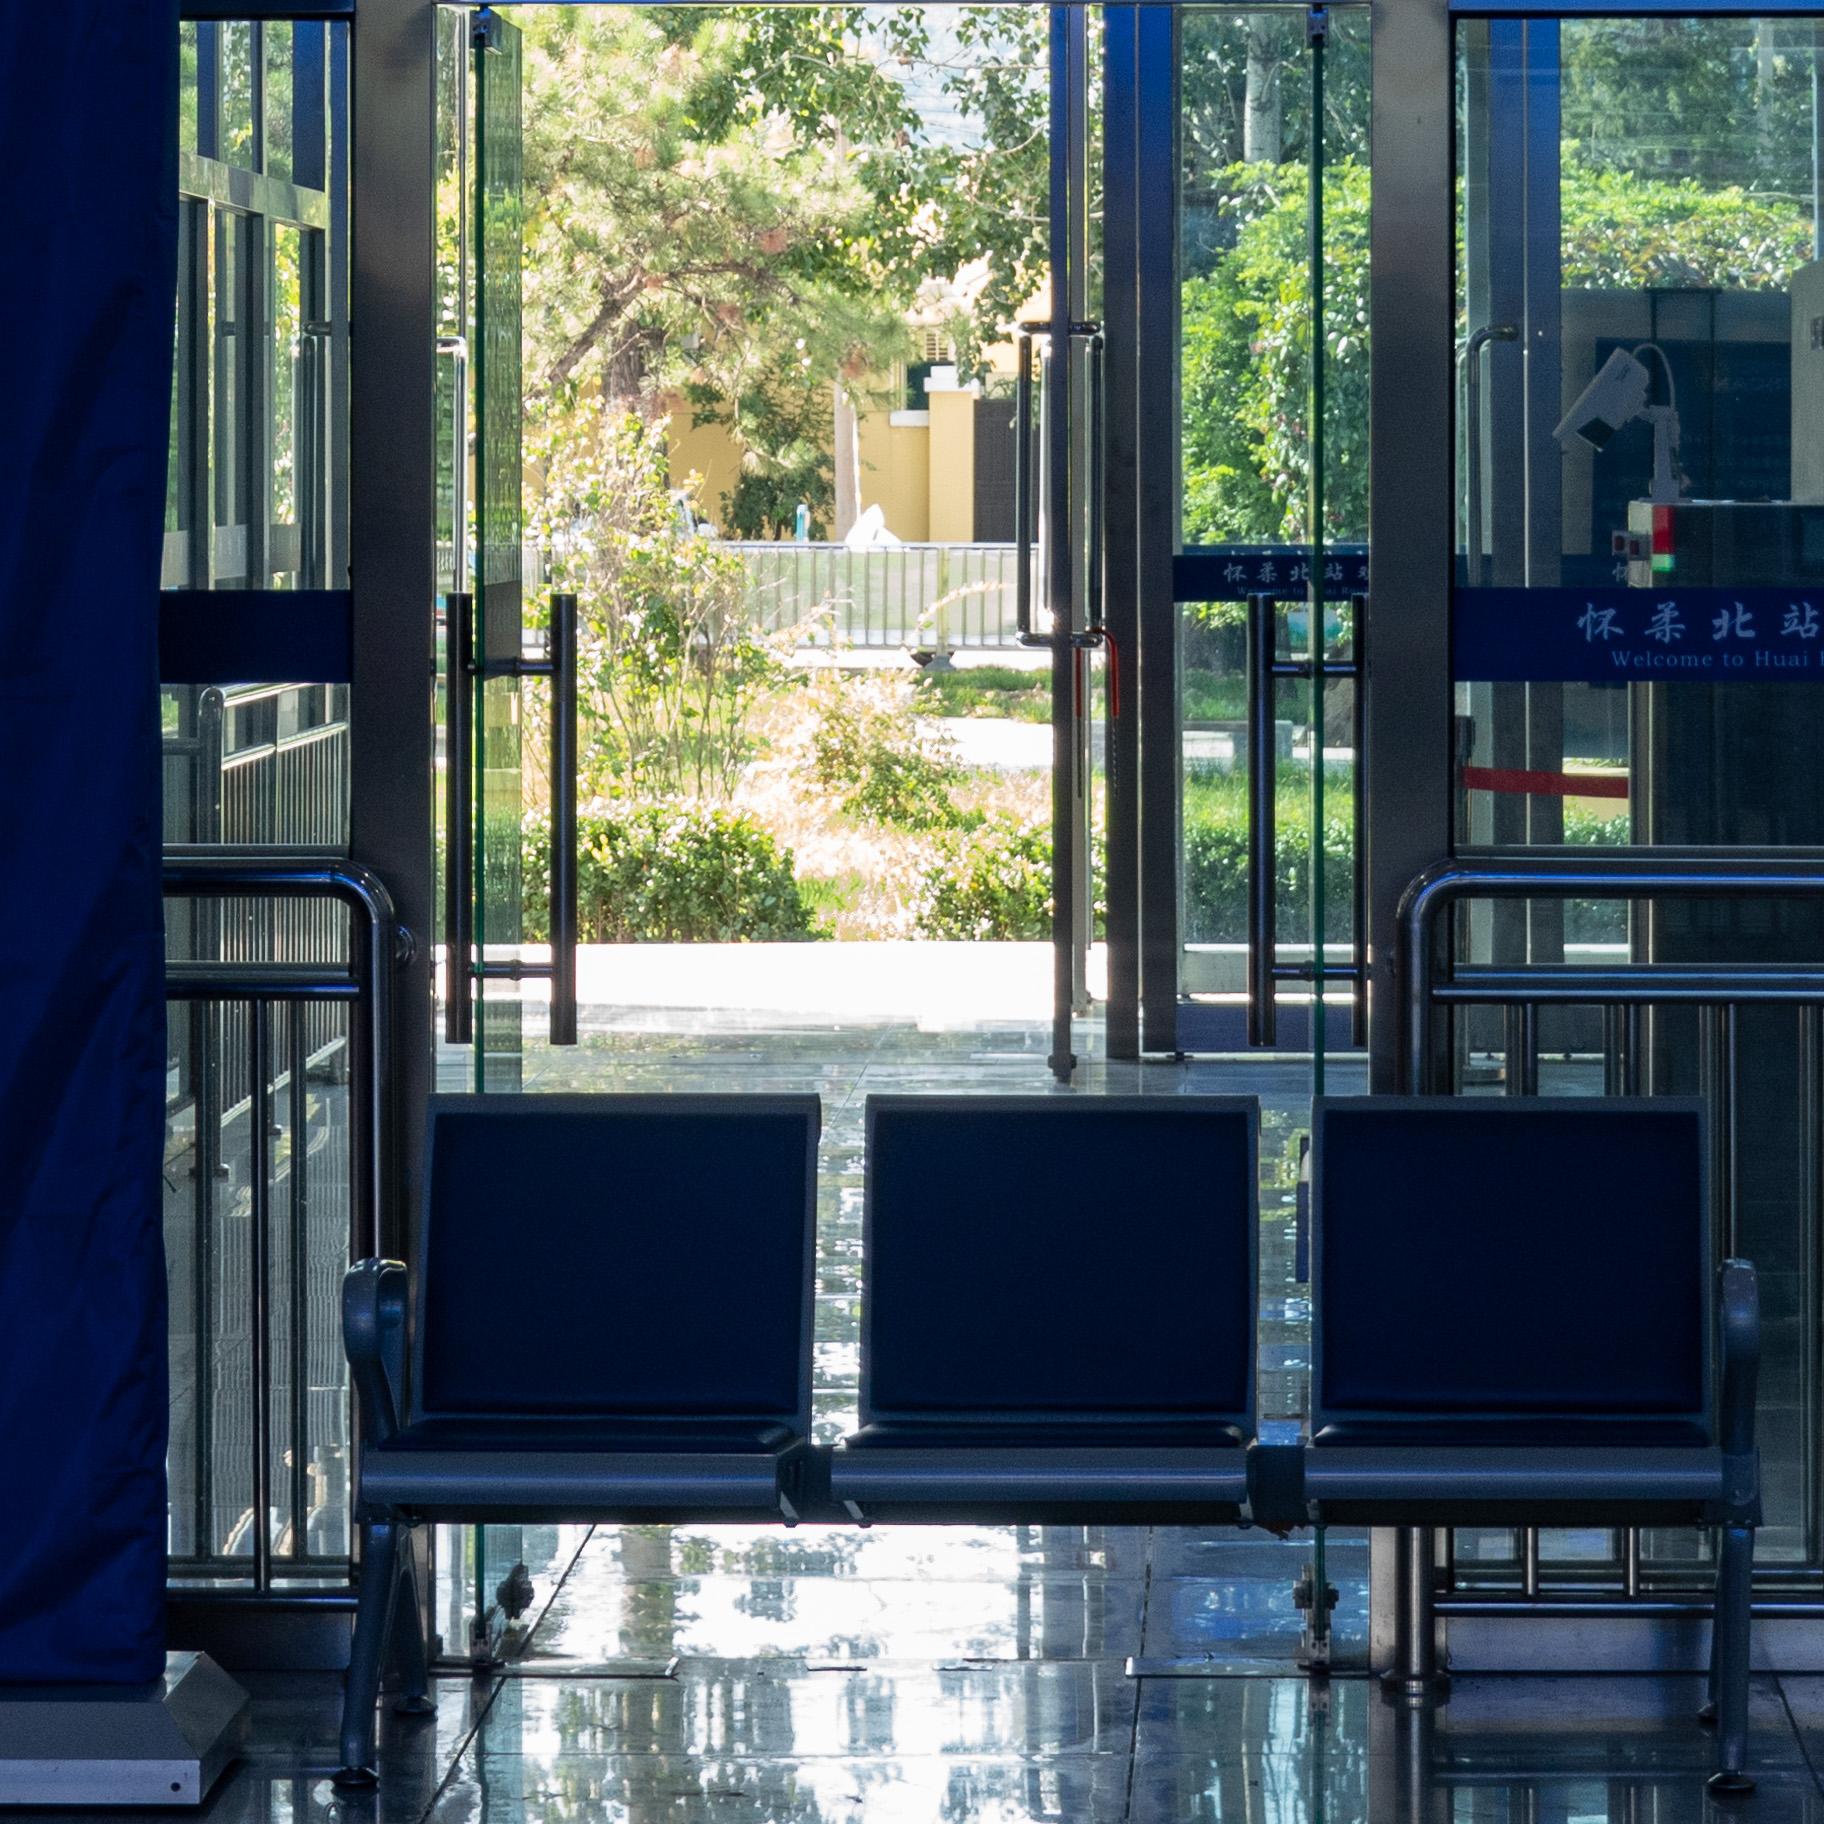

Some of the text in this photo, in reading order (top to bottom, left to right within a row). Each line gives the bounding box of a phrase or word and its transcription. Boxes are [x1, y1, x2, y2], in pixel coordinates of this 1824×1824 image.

[1612, 649, 1712, 667] Welcome
[1723, 649, 1744, 667] to
[1754, 649, 1809, 667] Huai
